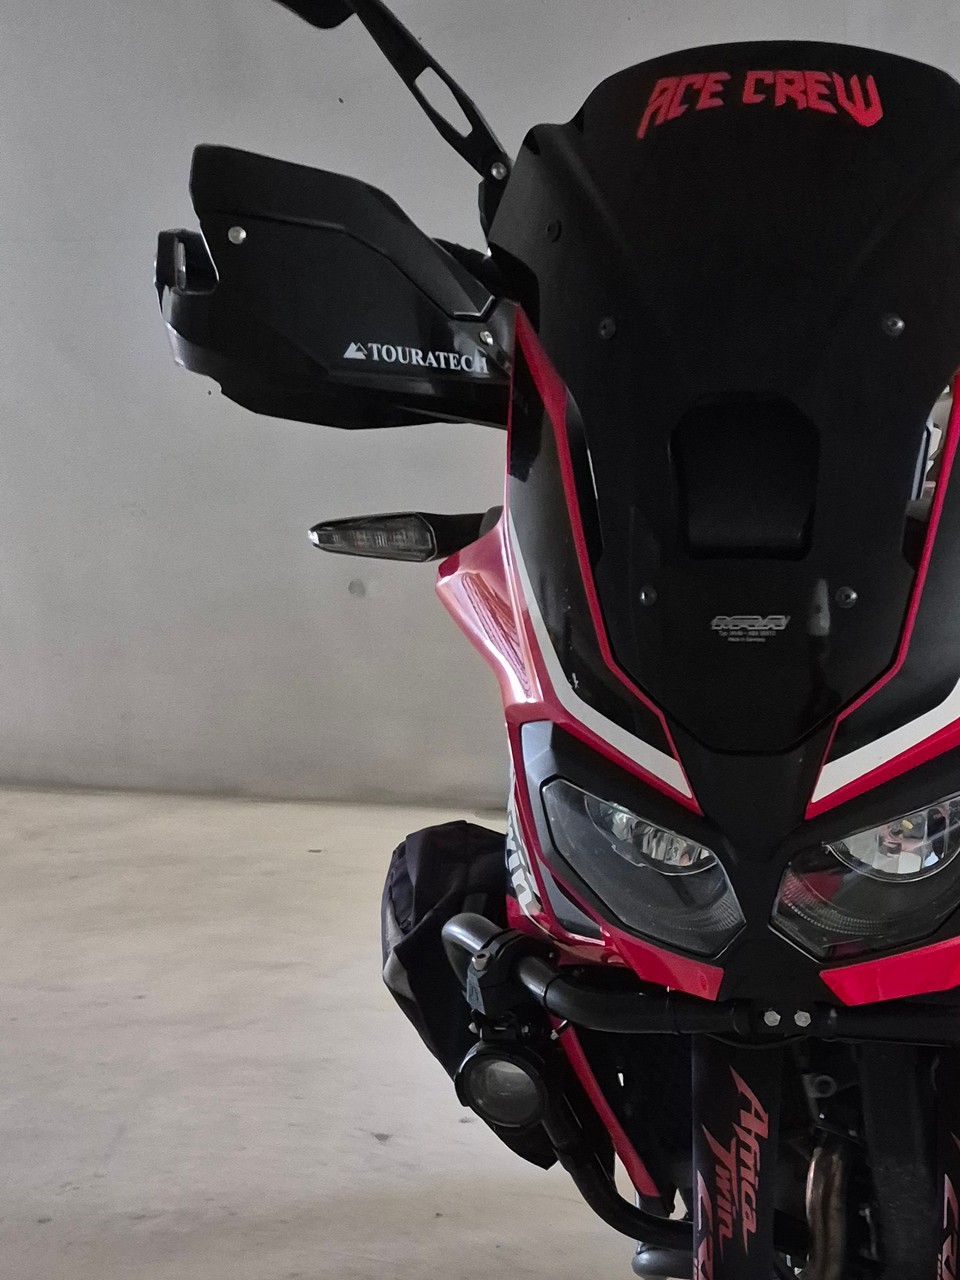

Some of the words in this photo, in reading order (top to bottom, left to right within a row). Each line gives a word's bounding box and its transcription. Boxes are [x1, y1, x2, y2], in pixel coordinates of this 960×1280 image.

[636, 71, 731, 139] ACE
[742, 70, 883, 127] CREW
[367, 342, 489, 374] TOURATECH
[701, 1122, 739, 1263] Twin
[729, 1064, 769, 1256] Africa
